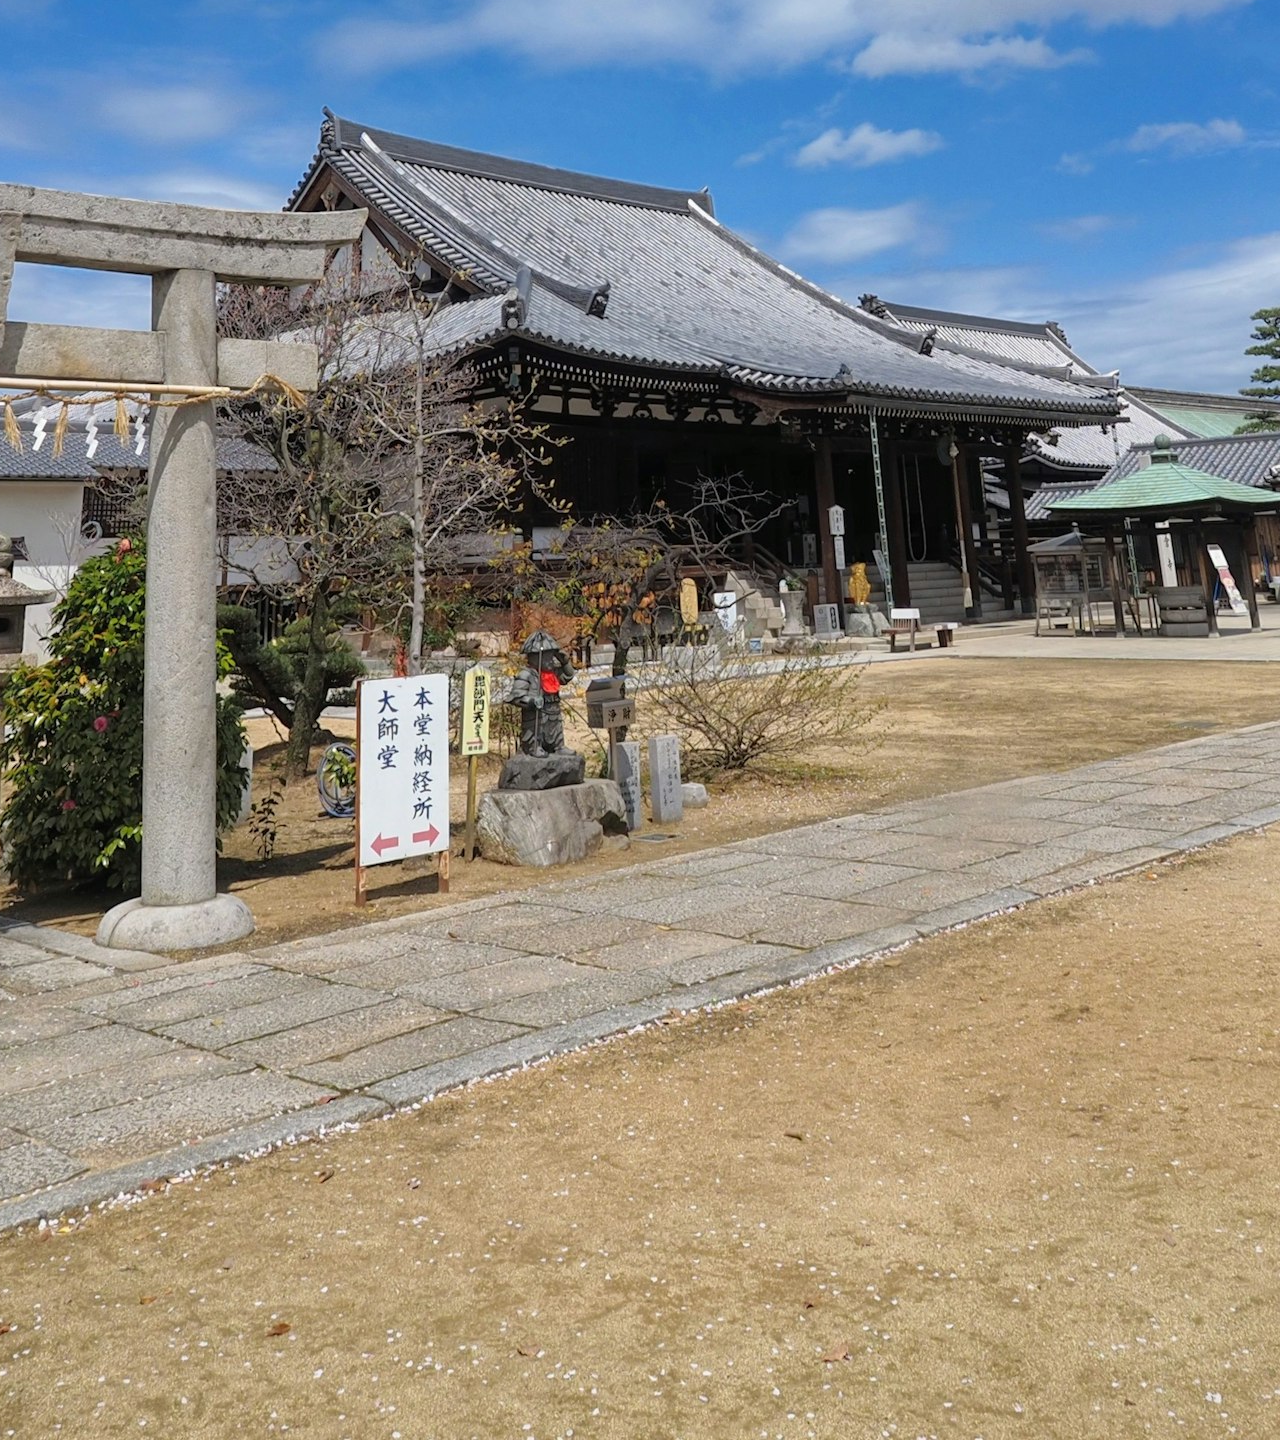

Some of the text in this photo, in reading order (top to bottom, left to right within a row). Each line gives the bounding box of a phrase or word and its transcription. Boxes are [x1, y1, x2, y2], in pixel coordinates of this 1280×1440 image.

[377, 690, 400, 770] 大師堂
[412, 686, 434, 820] 本堂・納経所
